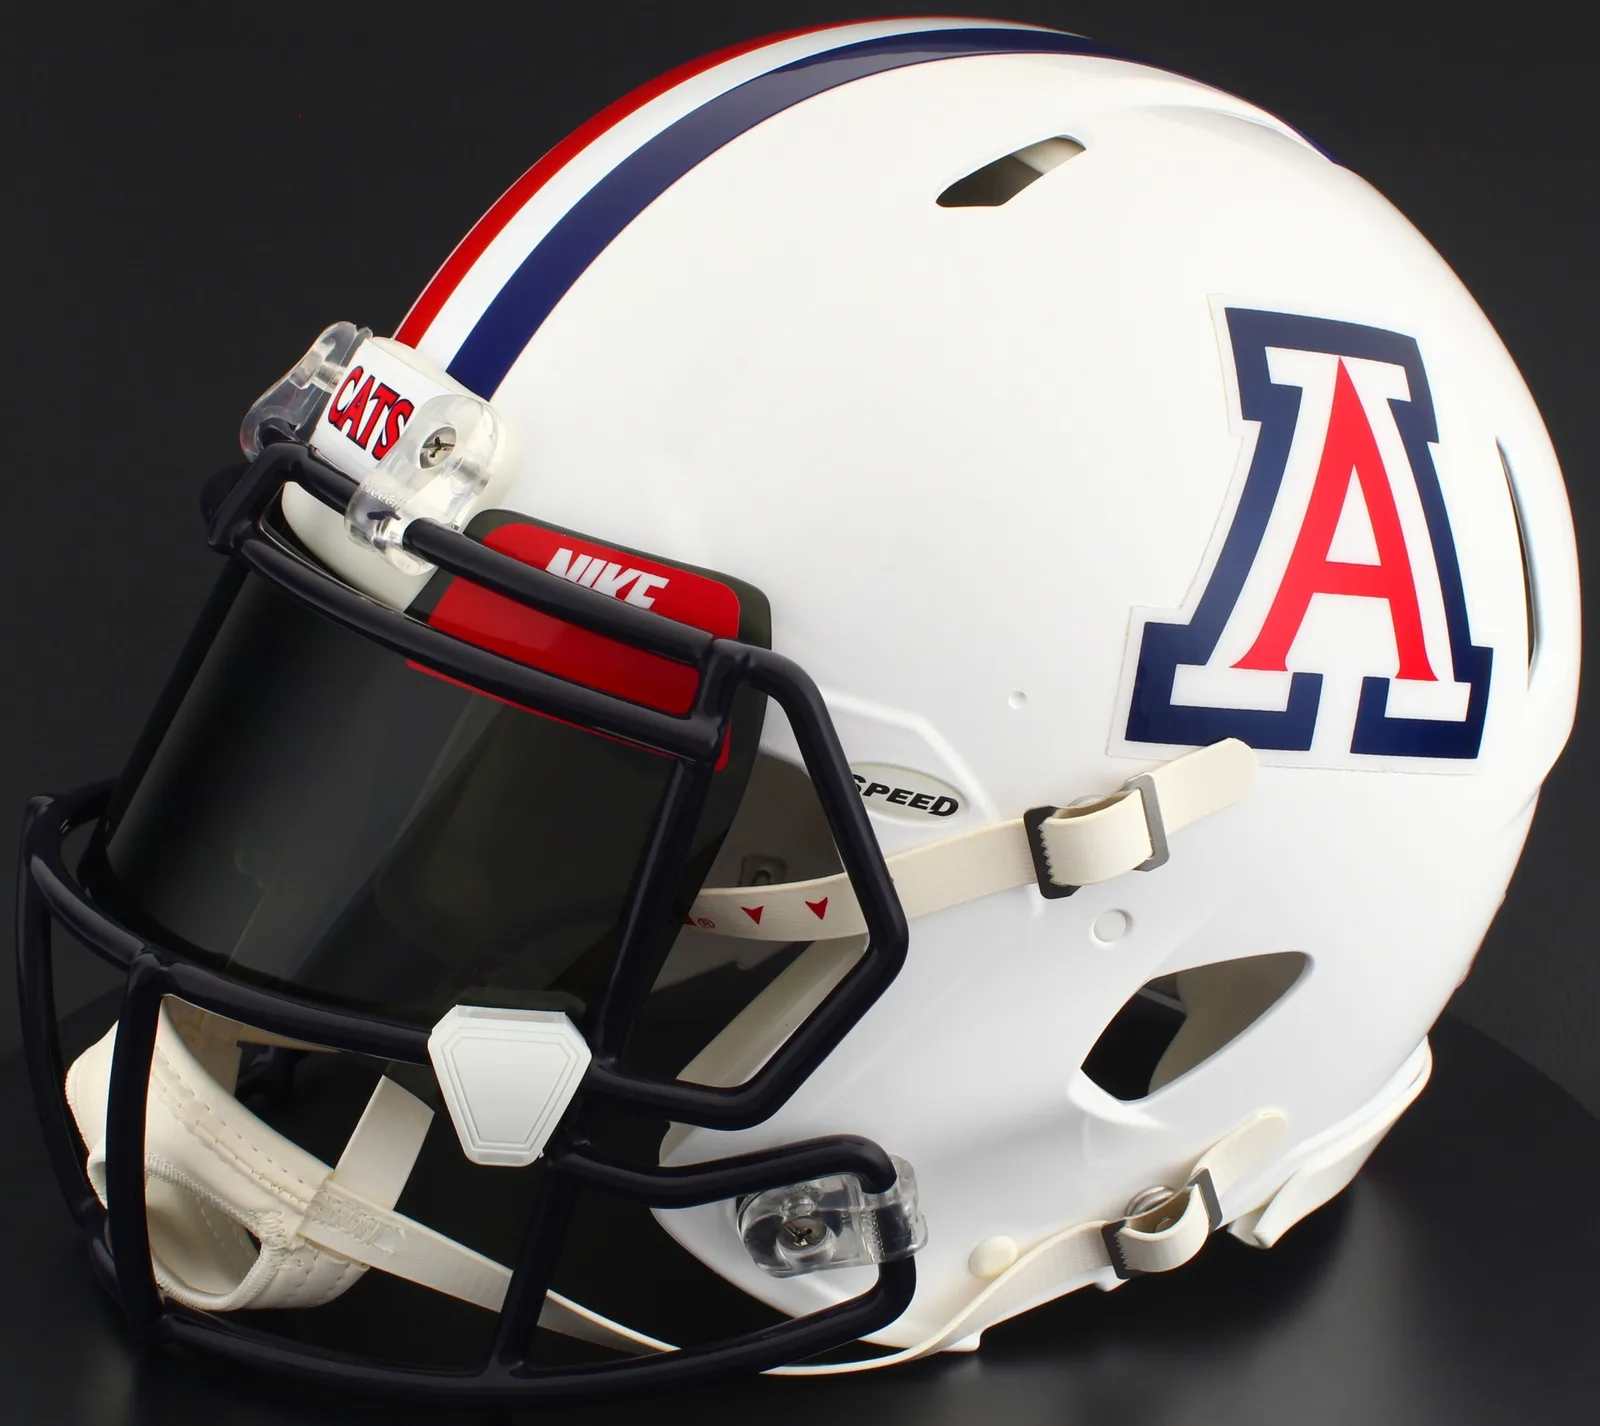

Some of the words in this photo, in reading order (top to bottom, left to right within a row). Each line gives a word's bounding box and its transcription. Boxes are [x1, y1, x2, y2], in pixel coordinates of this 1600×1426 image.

[328, 365, 415, 461] CATS
[1125, 307, 1493, 759] A
[545, 548, 670, 609] NIKE
[852, 773, 959, 817] SPEED
